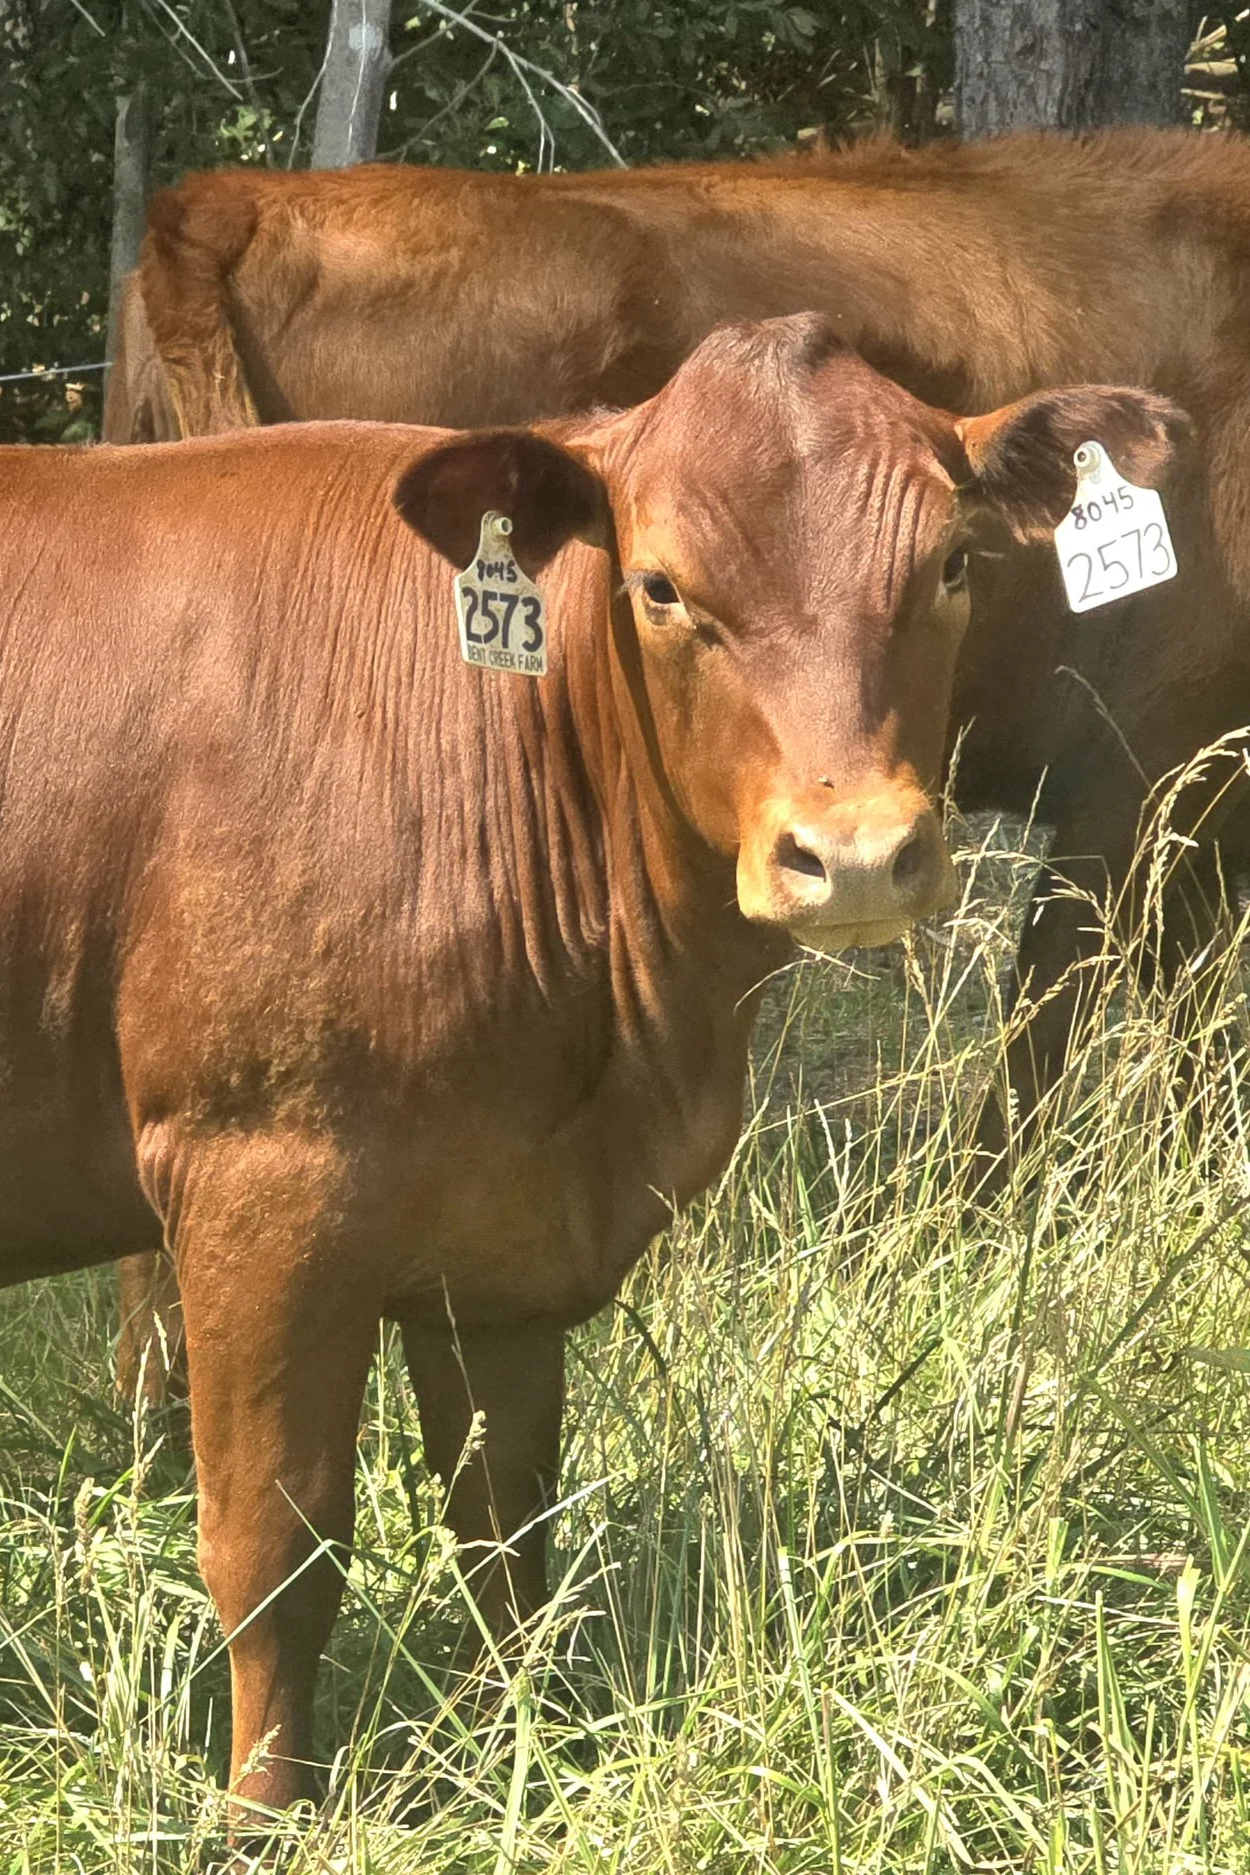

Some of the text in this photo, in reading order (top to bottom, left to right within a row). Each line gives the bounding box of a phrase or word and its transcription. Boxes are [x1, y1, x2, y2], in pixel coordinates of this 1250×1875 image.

[1071, 486, 1134, 530] 8045
[477, 560, 517, 583] 8045
[1067, 523, 1170, 603] 2573
[462, 587, 543, 652] 2573
[468, 645, 543, 672] BENT CREEK FARM
